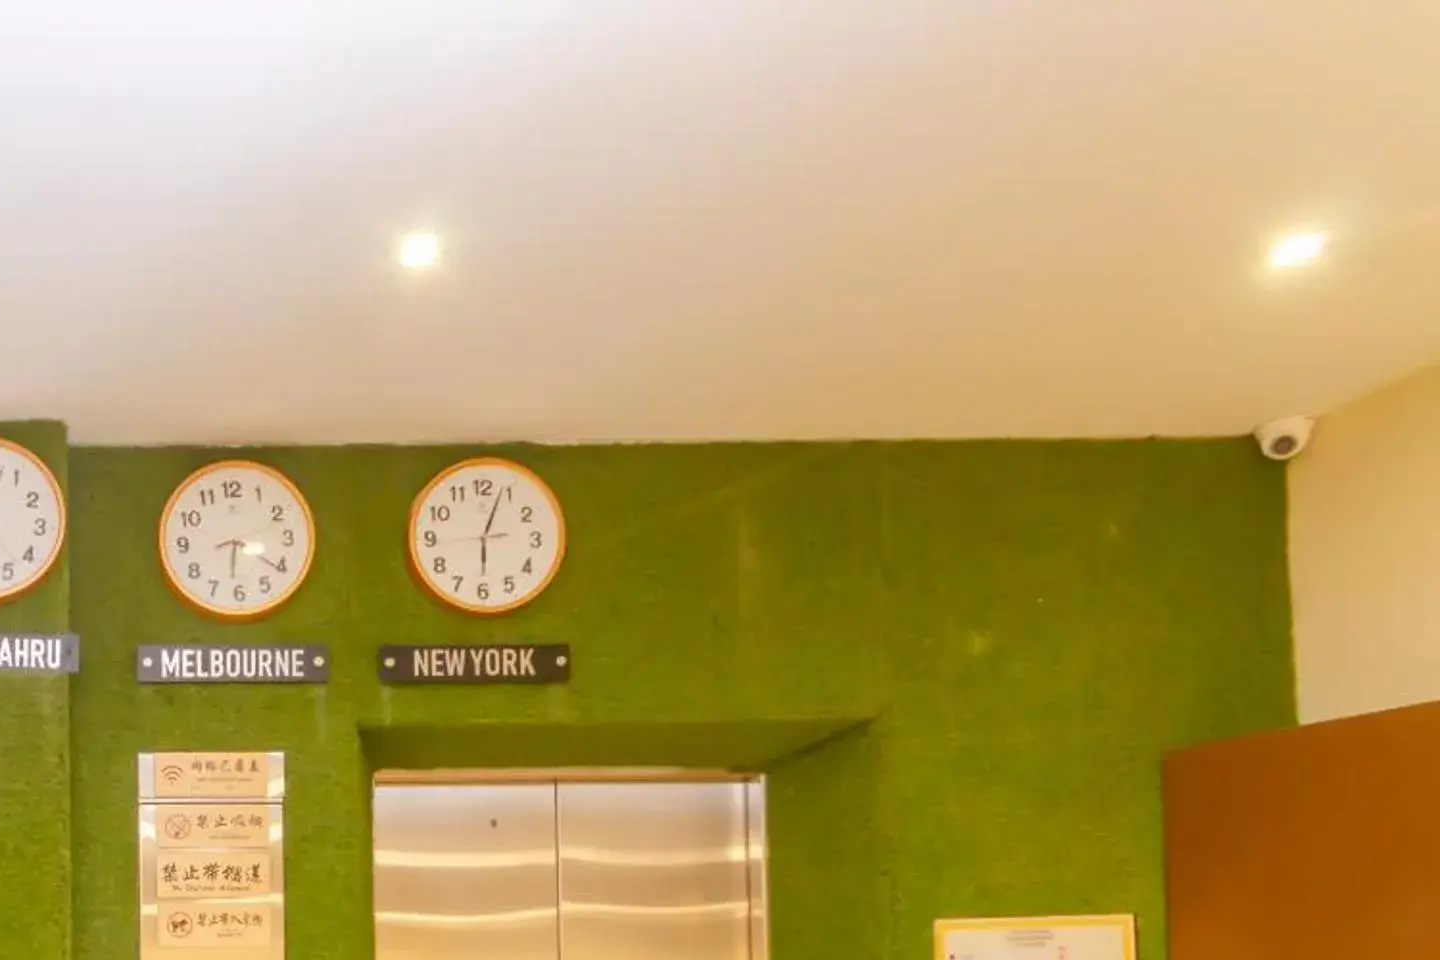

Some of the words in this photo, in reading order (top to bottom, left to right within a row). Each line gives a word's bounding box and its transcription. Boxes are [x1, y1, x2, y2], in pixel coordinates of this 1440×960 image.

[221, 480, 242, 498] 12
[450, 486, 465, 502] 11
[473, 479, 493, 496] 12
[26, 491, 39, 508] 2
[199, 490, 215, 506] 11
[180, 510, 201, 528] 10
[271, 504, 285, 521] 2
[430, 505, 450, 522] 10
[520, 506, 533, 523] 2
[34, 518, 46, 537] 3
[176, 537, 190, 553] 9
[282, 529, 294, 547] 3
[424, 530, 437, 548] 9
[529, 531, 542, 549] 3
[22, 545, 34, 562] 4
[2, 563, 14, 581] 5
[188, 562, 201, 579] 8
[276, 556, 287, 573] 4
[433, 557, 446, 573] 8
[521, 557, 532, 574] 4
[208, 580, 219, 597] 7
[260, 576, 271, 593] 5
[452, 575, 464, 592] 7
[477, 583, 489, 600] 6
[503, 576, 515, 594] 5
[234, 585, 246, 602] 6
[160, 647, 305, 680] MELBOURNE
[412, 648, 465, 678] NEW
[468, 647, 537, 678] YORK
